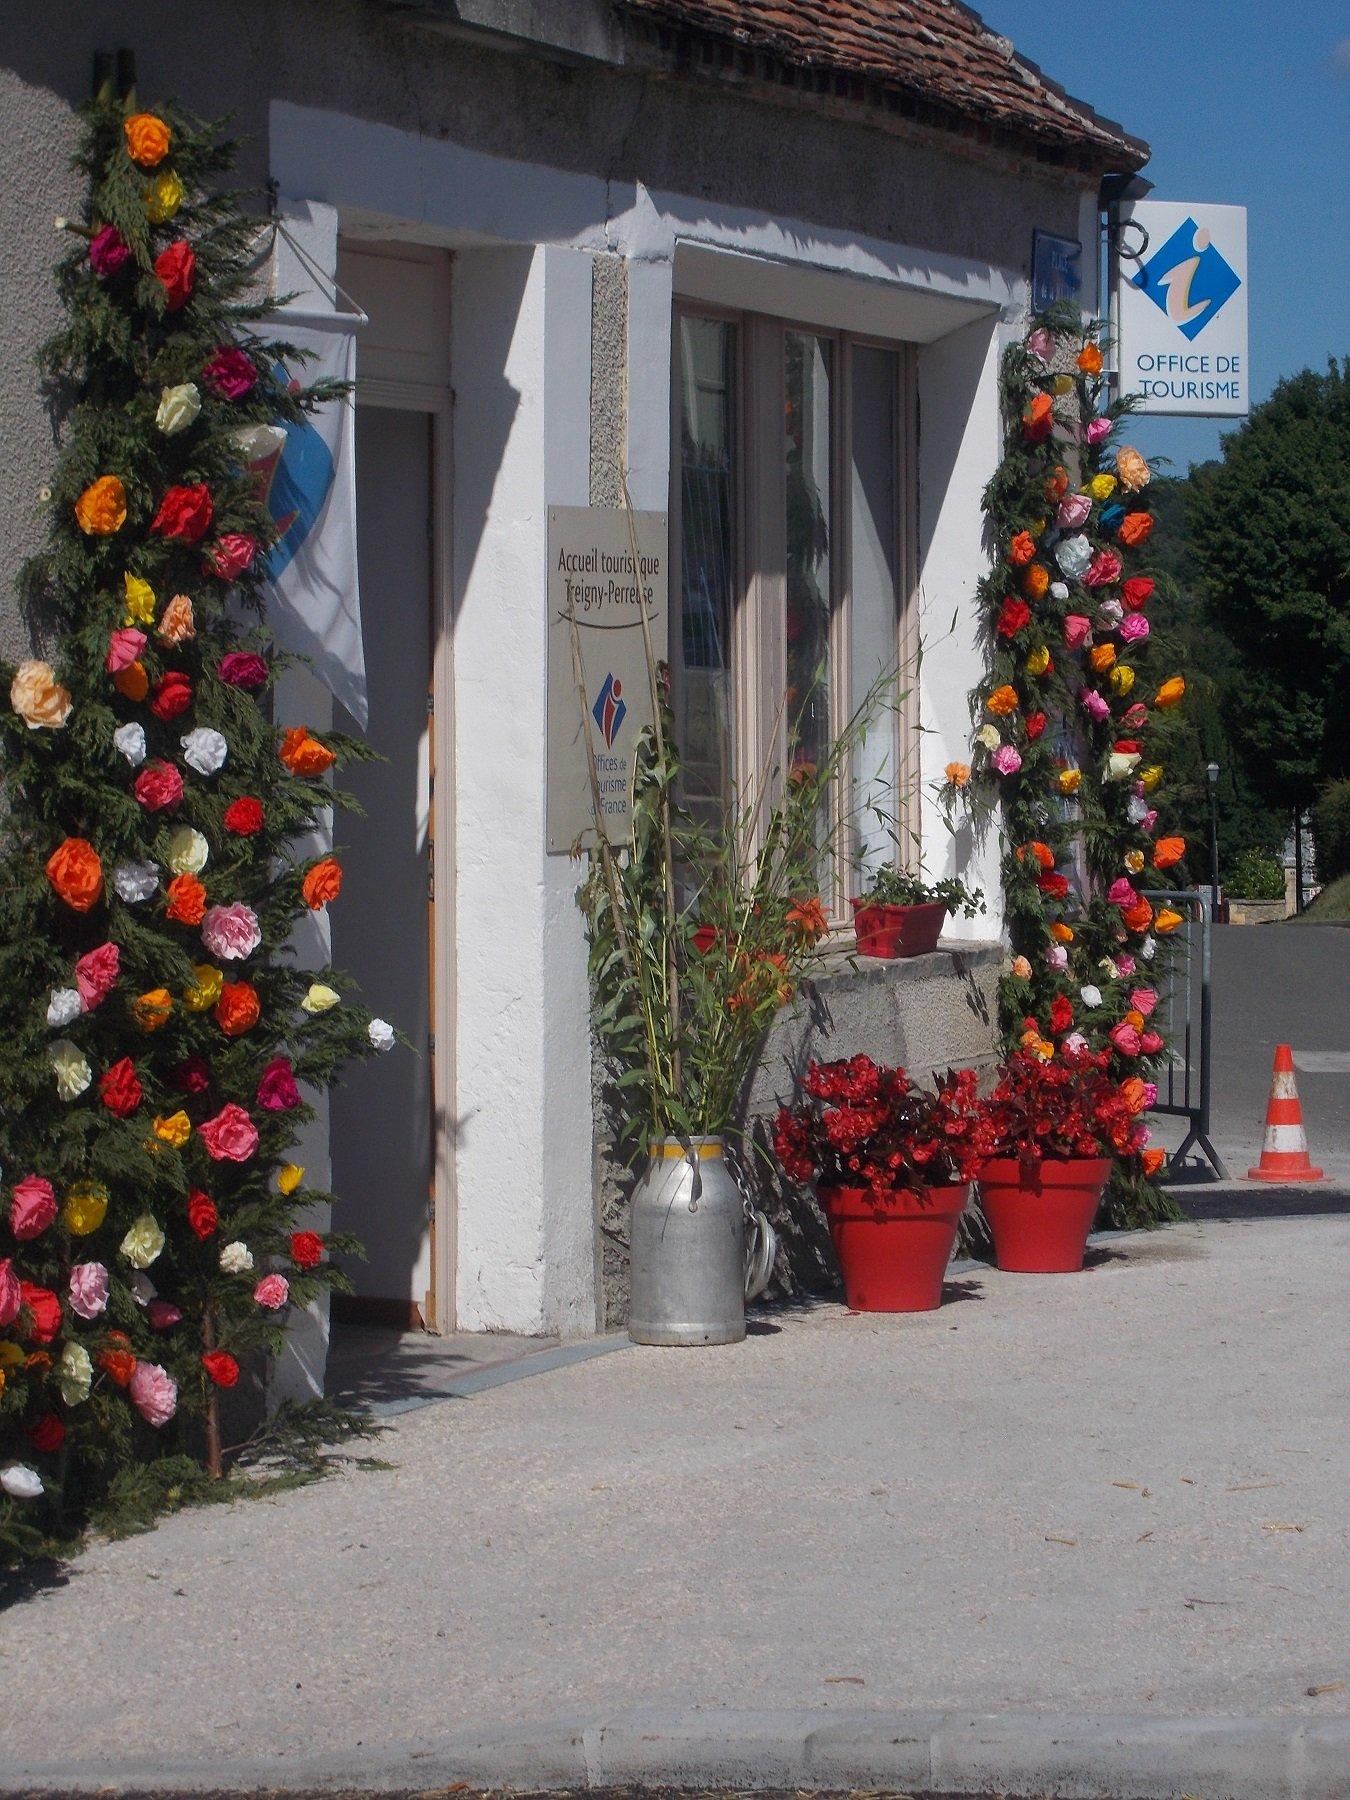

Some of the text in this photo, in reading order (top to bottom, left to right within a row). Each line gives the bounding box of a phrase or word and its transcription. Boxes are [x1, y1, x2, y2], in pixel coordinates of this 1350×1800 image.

[1137, 354, 1240, 373] OFFICE DE
[1138, 380, 1240, 399] TOURISME
[557, 547, 598, 573] Accueil
[597, 775, 627, 793] urisme
[600, 797, 627, 815] France
